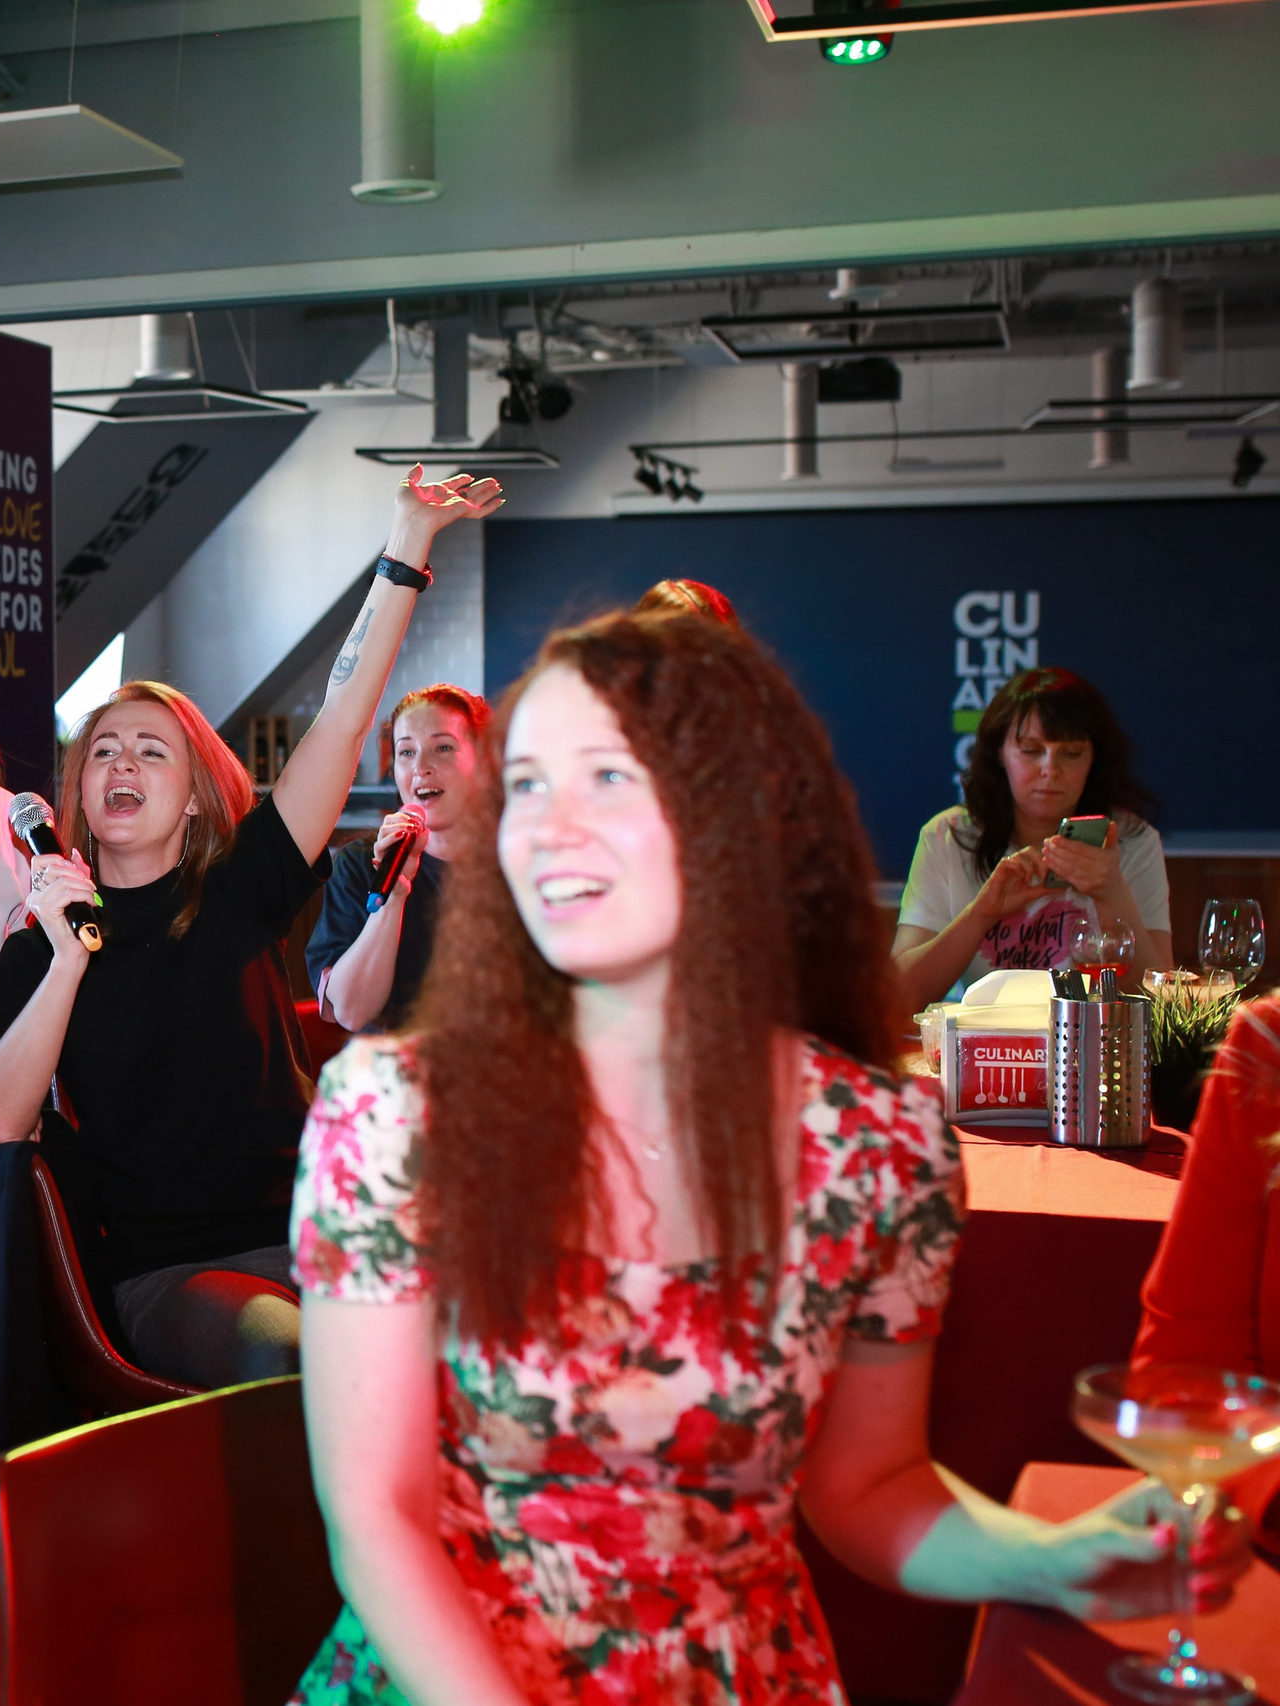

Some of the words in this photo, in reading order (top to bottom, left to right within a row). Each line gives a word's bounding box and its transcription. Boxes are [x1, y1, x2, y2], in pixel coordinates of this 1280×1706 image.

[0, 590, 44, 633] FOR
[953, 590, 1040, 638] CU
[955, 637, 1039, 677] LIN
[984, 918, 1012, 951] do
[1019, 910, 1080, 949] what
